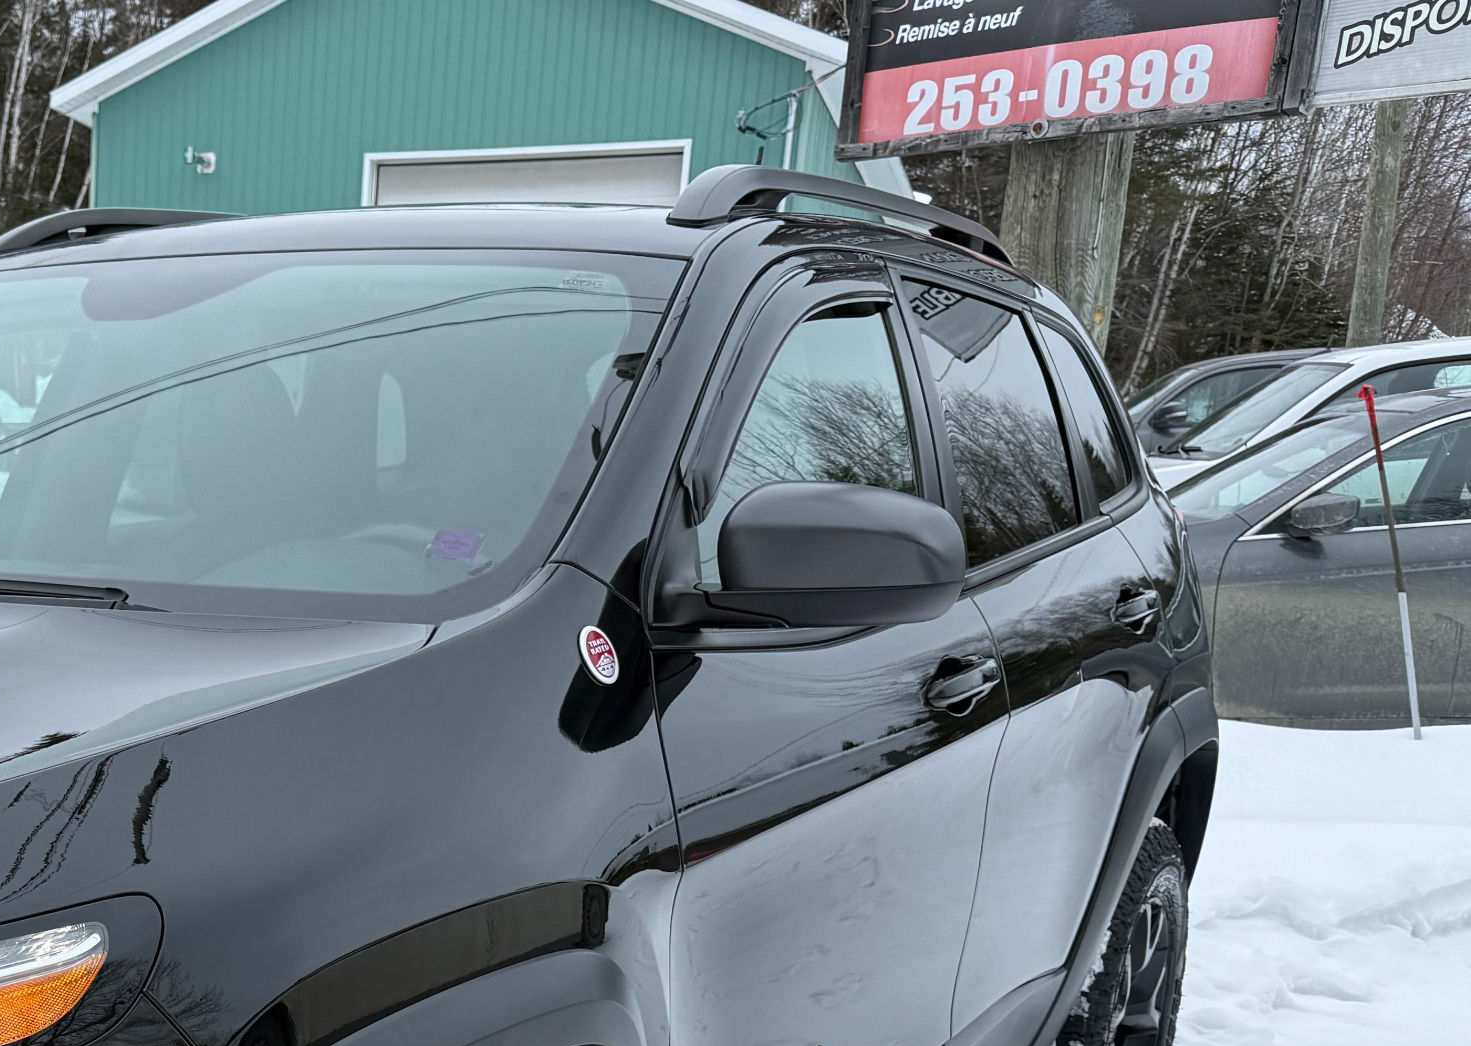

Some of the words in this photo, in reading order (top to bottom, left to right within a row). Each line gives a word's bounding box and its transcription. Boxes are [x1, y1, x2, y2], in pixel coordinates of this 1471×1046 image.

[895, 18, 960, 45] Remise
[962, 13, 976, 34] à
[977, 5, 1025, 32] neuf
[1334, 0, 1471, 69] DISPO
[904, 43, 1214, 136] 253-0398
[588, 638, 606, 648] TRAIL
[590, 644, 610, 656] RATED
